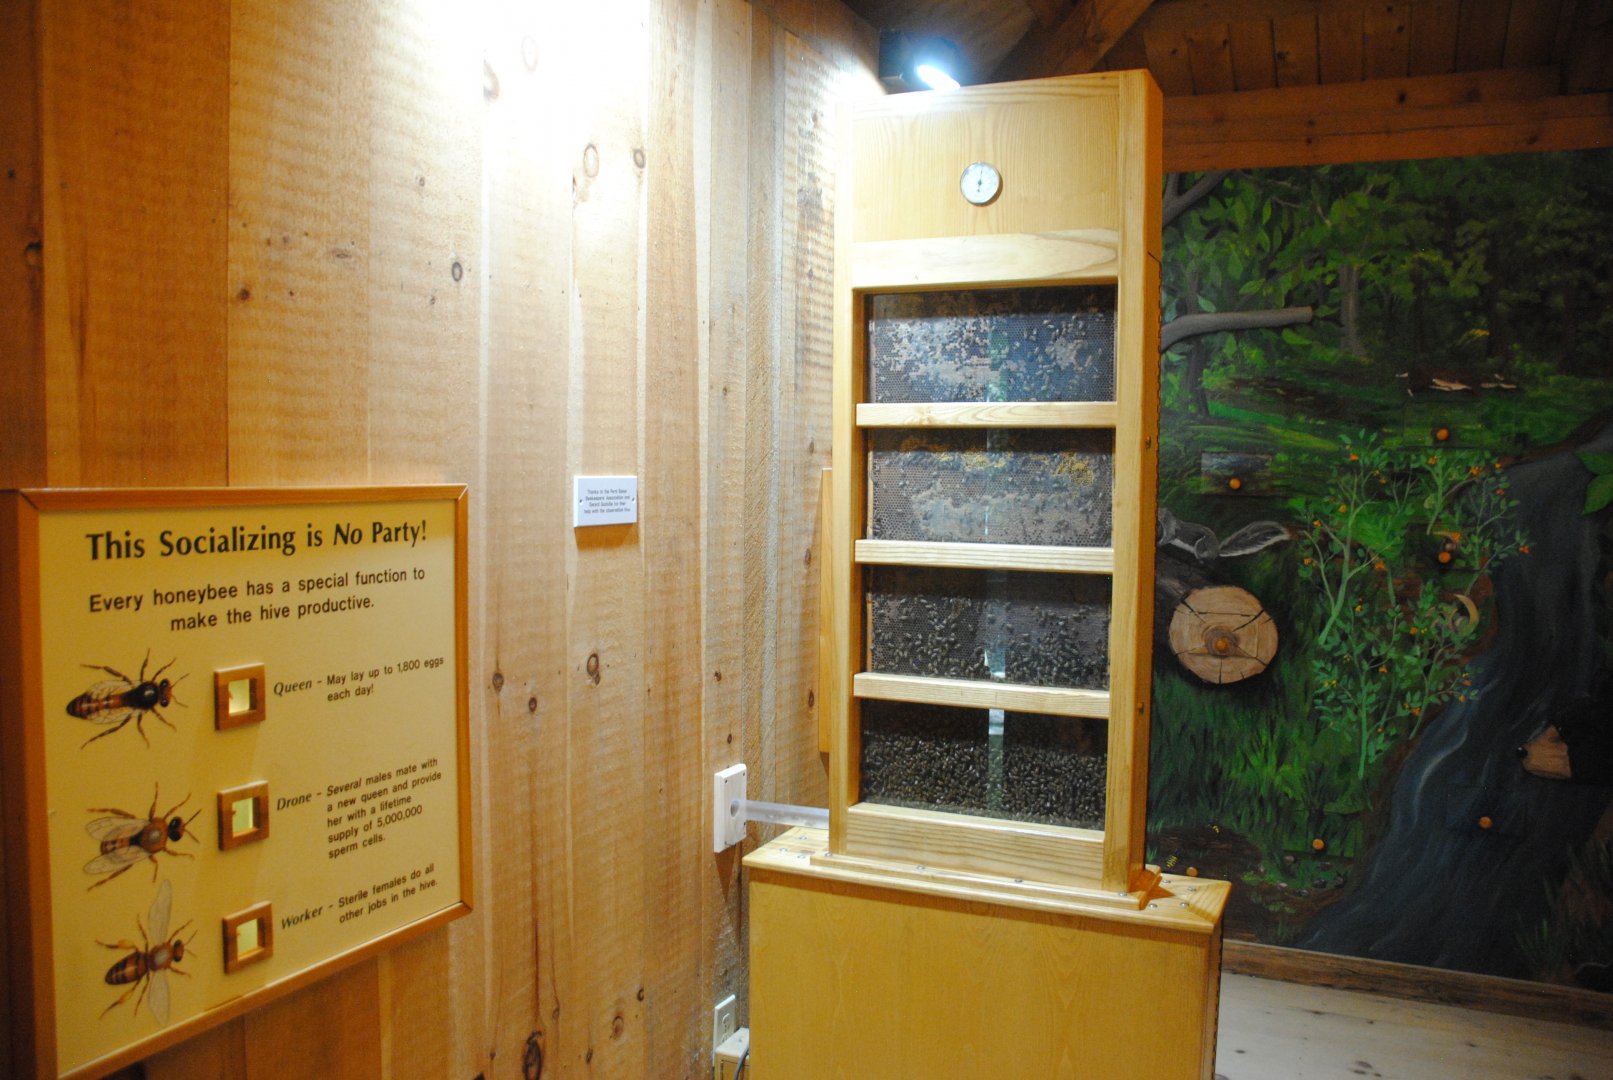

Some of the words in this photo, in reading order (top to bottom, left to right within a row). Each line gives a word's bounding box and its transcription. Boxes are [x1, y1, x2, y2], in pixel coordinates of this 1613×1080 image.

[86, 531, 145, 561] This
[160, 526, 296, 557] Socializing
[307, 524, 323, 546] is
[333, 522, 363, 546] No
[372, 520, 427, 548] Party!
[89, 590, 143, 612] Every
[153, 582, 238, 606] honeybee
[246, 577, 274, 596] has
[281, 580, 291, 592] a
[298, 572, 349, 593] special
[356, 568, 407, 585] function
[413, 567, 426, 580] to
[171, 611, 218, 631] make
[227, 606, 252, 624] the
[260, 602, 291, 621] hive
[298, 596, 374, 619] productive.
[273, 678, 312, 697] Queen
[327, 674, 346, 687] May
[351, 671, 364, 683] lay
[368, 669, 380, 679] up
[384, 665, 393, 674] to
[424, 656, 444, 669] eggs
[327, 689, 351, 702] each
[355, 684, 374, 697] day!
[277, 791, 312, 811] Drone
[327, 777, 362, 797] Several
[366, 772, 392, 786] males
[396, 764, 417, 778] mate
[421, 758, 438, 770] with
[327, 803, 333, 812] a
[337, 796, 357, 809] new
[361, 787, 389, 804] queen
[392, 781, 408, 793] and
[412, 771, 442, 789] provide
[327, 815, 342, 828] her
[347, 807, 367, 822] with
[370, 805, 376, 814] a
[380, 794, 412, 812] lifetime
[328, 826, 359, 843] supply
[363, 821, 373, 833] of
[377, 804, 423, 829] 5,000,000
[328, 842, 358, 859] sperm
[362, 834, 386, 849] cells.
[281, 904, 323, 930] Worker
[338, 889, 368, 909] Sterile
[372, 876, 407, 895] females
[411, 868, 421, 882] do
[425, 864, 435, 877] all
[339, 908, 363, 924] other
[367, 896, 388, 914] jobs
[391, 892, 399, 903] in
[403, 886, 416, 899] the
[420, 879, 439, 893] hive.
